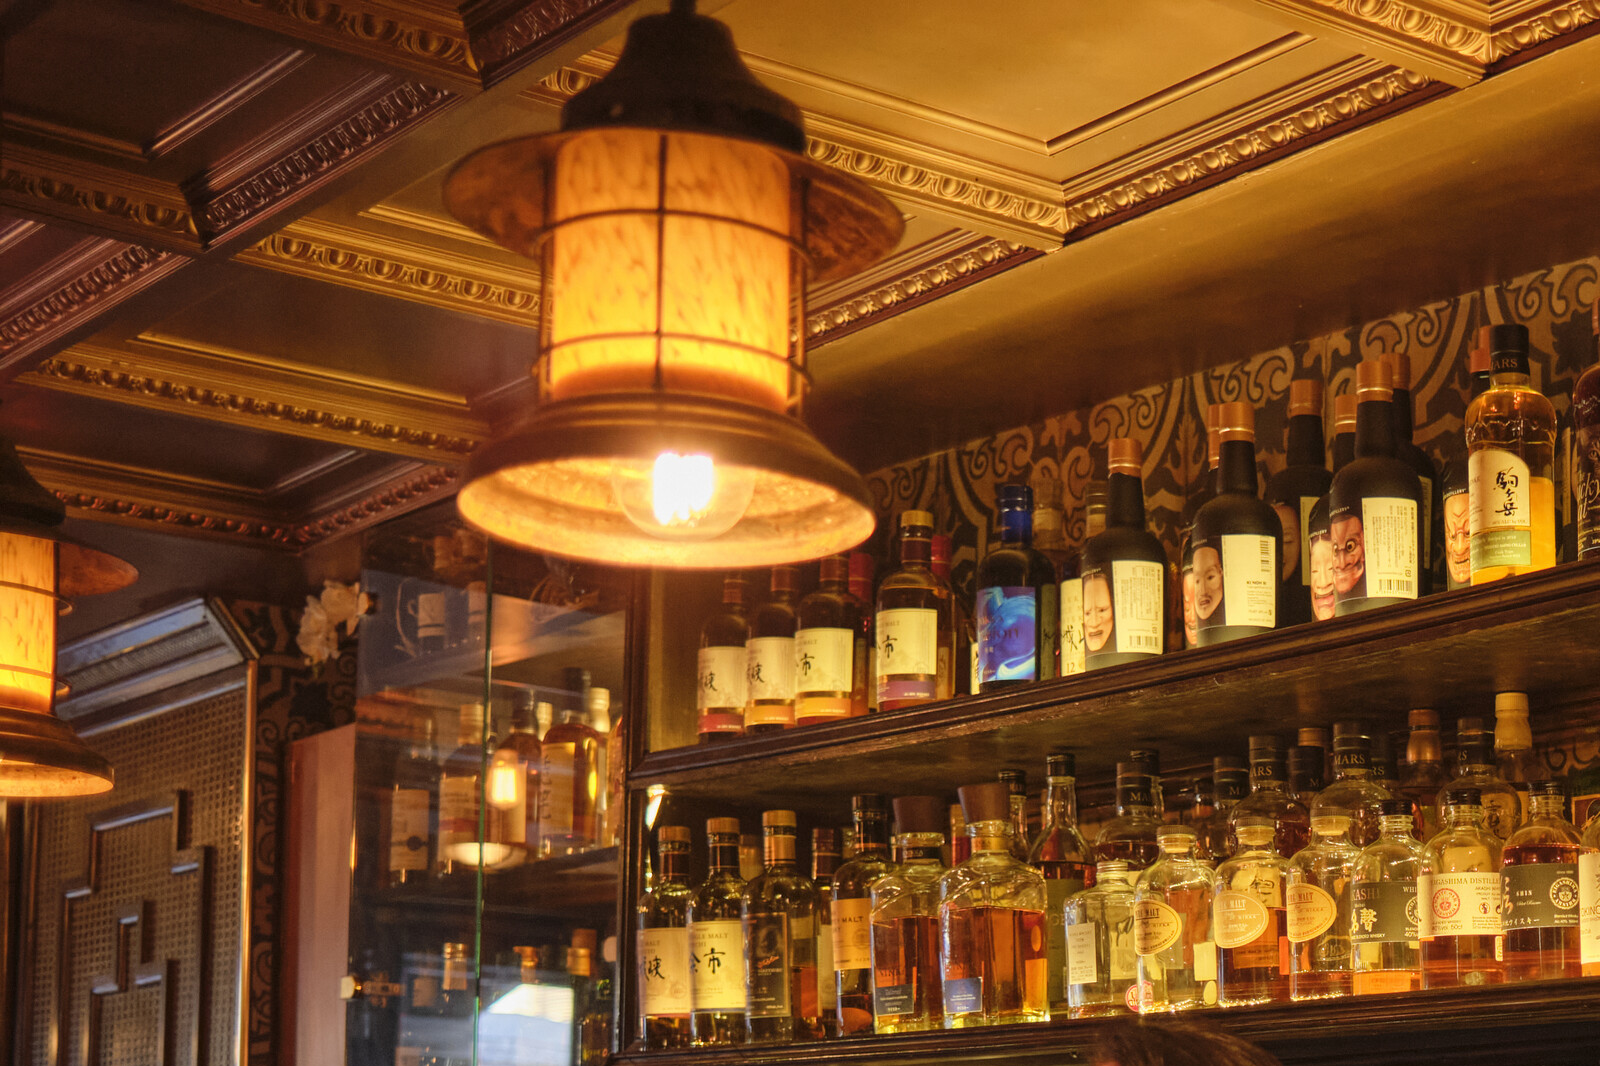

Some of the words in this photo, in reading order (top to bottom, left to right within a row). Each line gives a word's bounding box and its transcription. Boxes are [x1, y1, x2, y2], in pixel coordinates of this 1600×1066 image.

[1491, 357, 1518, 370] ARS
[1494, 467, 1519, 517] 駒ヶ岳
[881, 634, 898, 659] 市
[796, 652, 815, 677] 市
[1066, 662, 1075, 673] 12
[1334, 753, 1366, 766] MARS
[1130, 791, 1149, 801] MA
[1470, 876, 1500, 885] DISTILLE
[1230, 899, 1246, 909] MALT
[842, 915, 864, 923] MALT
